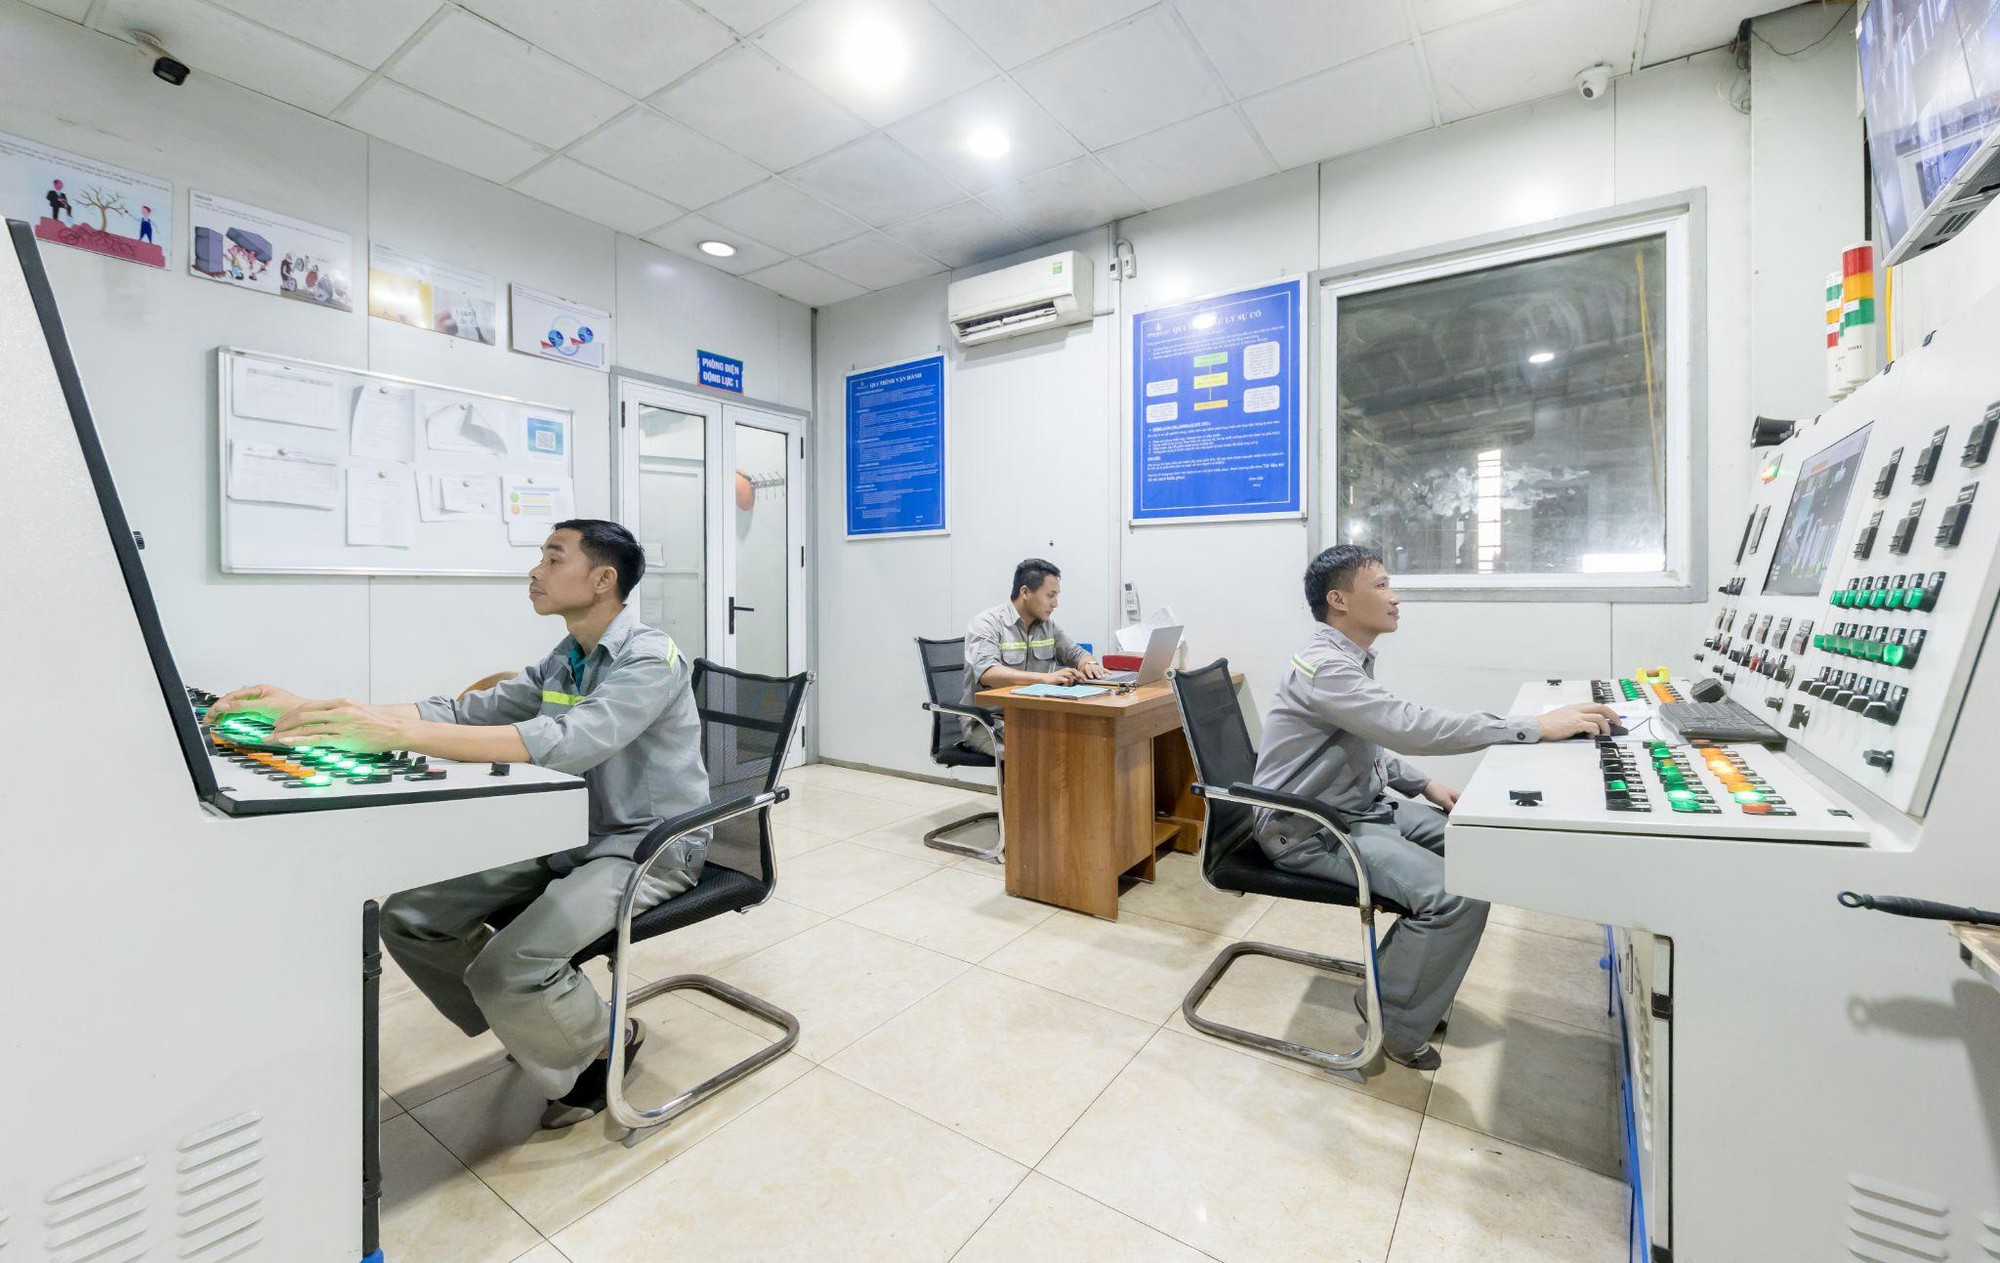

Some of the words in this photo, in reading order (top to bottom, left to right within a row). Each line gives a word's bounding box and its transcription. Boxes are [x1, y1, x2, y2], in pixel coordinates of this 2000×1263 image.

[702, 357, 724, 372] PHÒNG
[725, 363, 739, 376] ĐIỆN
[703, 370, 721, 384] ĐỘNG
[721, 375, 734, 387] LỰC
[735, 379, 739, 388] 1
